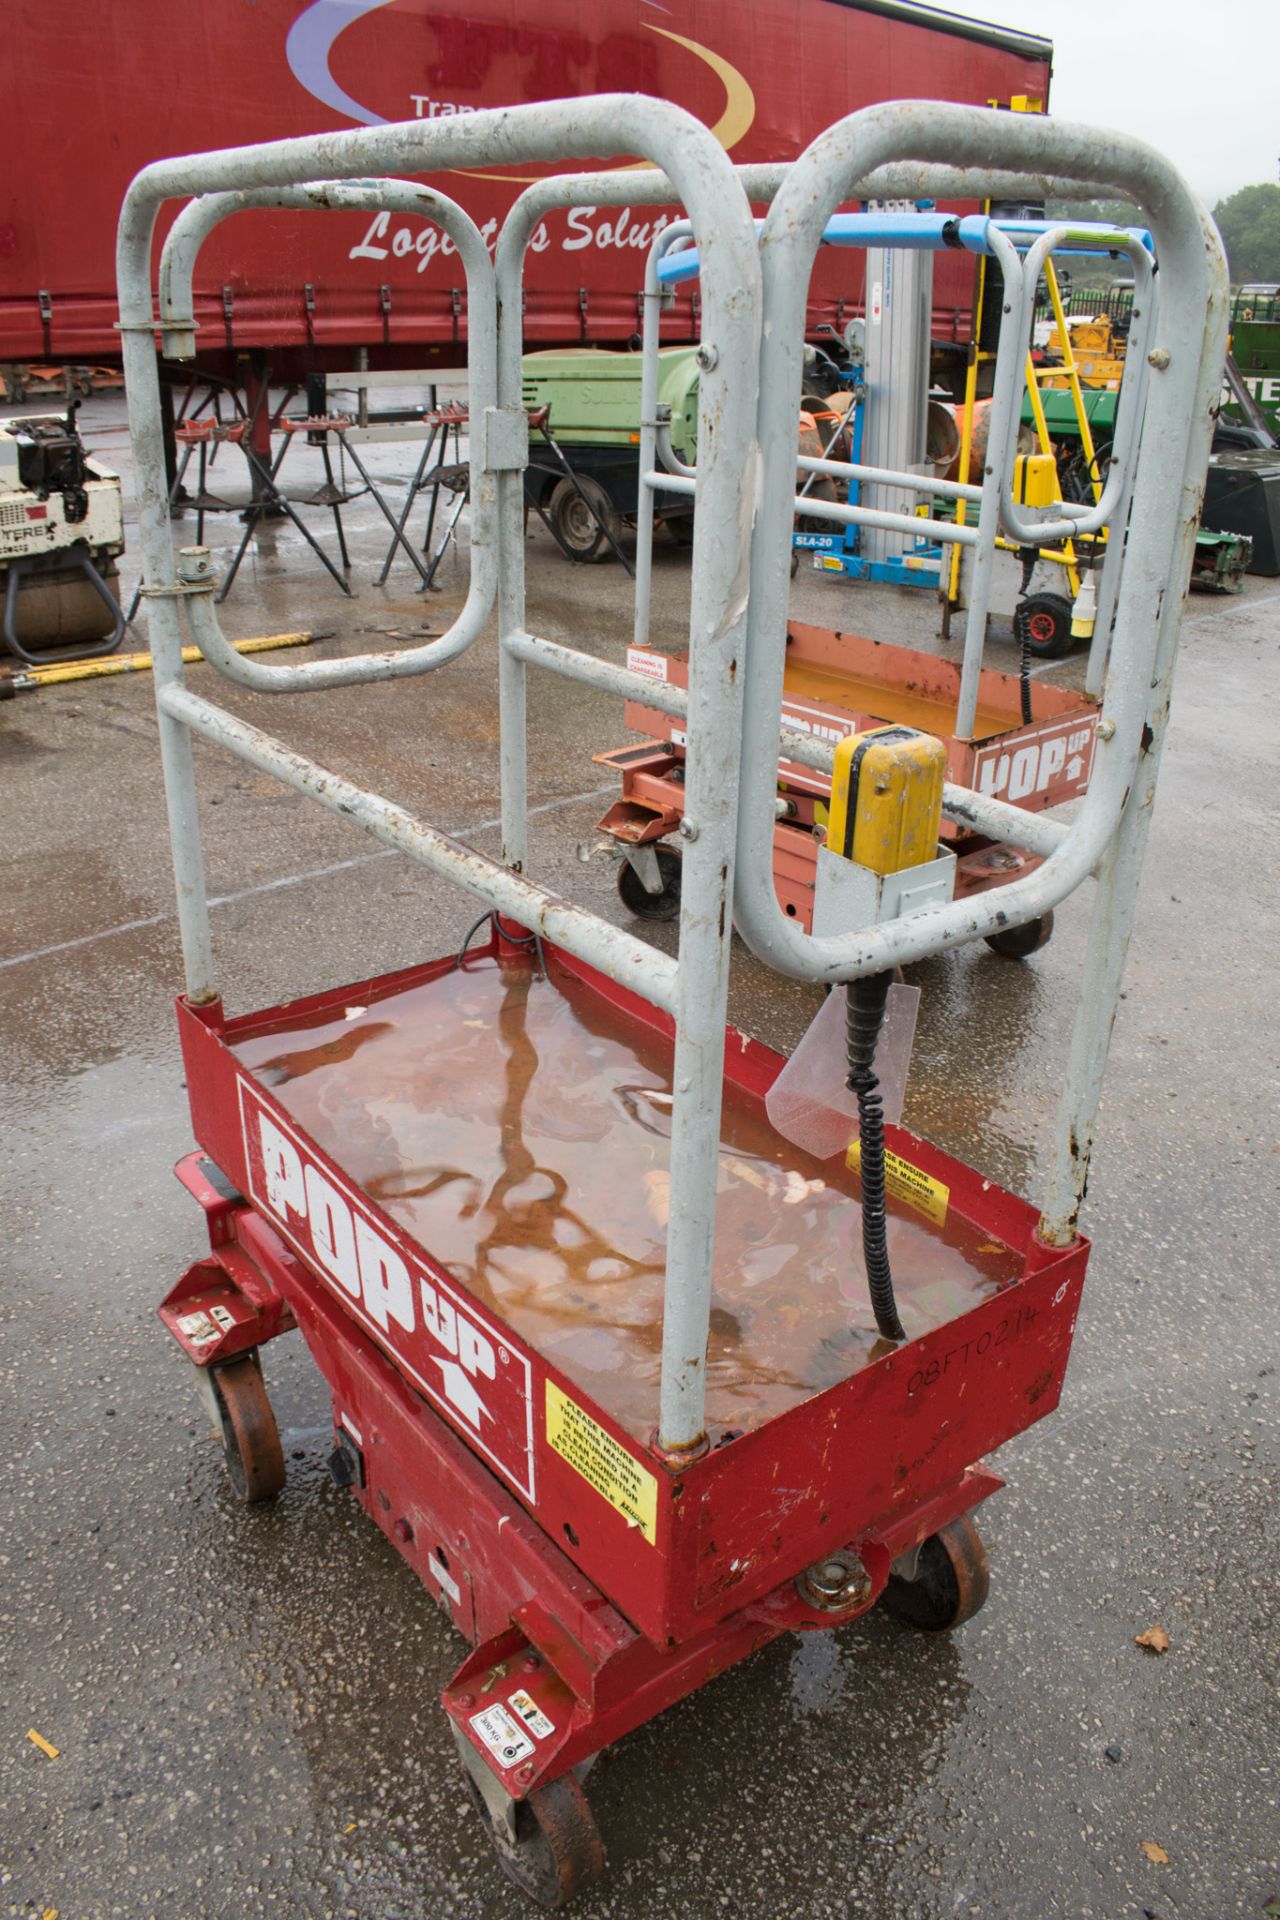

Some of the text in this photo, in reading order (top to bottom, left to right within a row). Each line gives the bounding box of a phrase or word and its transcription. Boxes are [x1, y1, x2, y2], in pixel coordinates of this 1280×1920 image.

[795, 536, 833, 547] SLA-20
[883, 1163, 935, 1196] HIS MACHINE
[898, 1159, 929, 1183] ENSURE
[258, 1110, 416, 1334] POP
[556, 1433, 610, 1488] AS CLEANING
[560, 1403, 642, 1486] THAT THIS MACHINE
[562, 1428, 638, 1504] CLEAN CONDITION
[563, 1418, 637, 1491] IS RETURNED IN A
[566, 1400, 635, 1467] PLEASE ENSURE
[551, 1438, 616, 1504] IS CHARGEABLE
